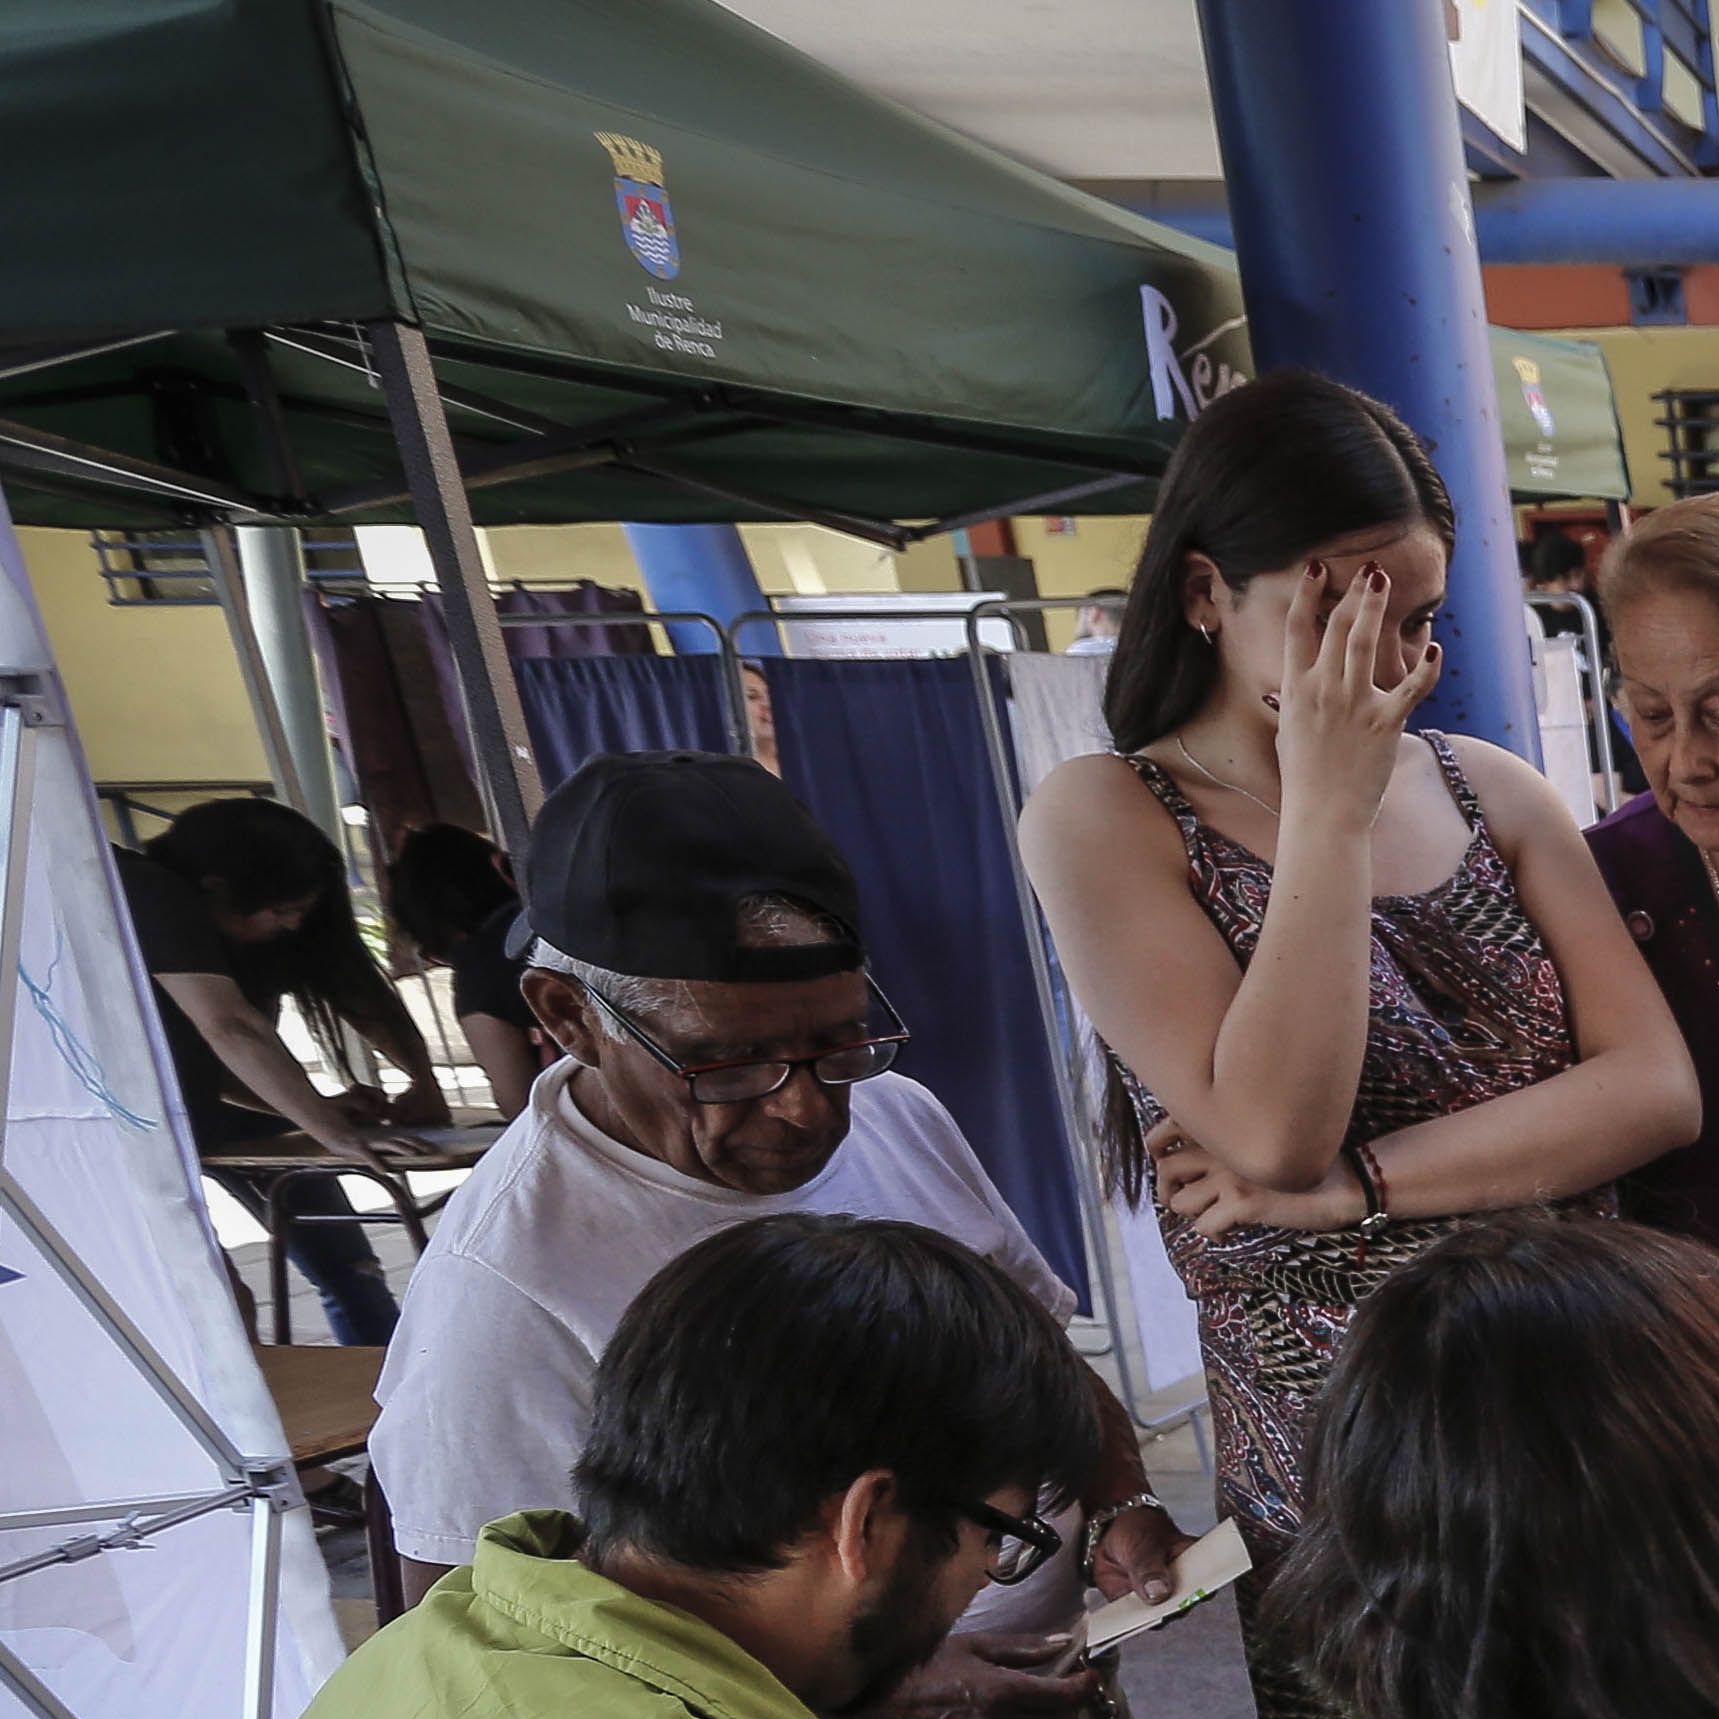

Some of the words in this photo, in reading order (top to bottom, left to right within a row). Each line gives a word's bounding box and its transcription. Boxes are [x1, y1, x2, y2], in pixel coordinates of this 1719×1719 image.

[646, 286, 694, 312] Ilustre
[626, 303, 723, 340] Municipalidad
[654, 330, 674, 351] de
[673, 332, 716, 358] Renca
